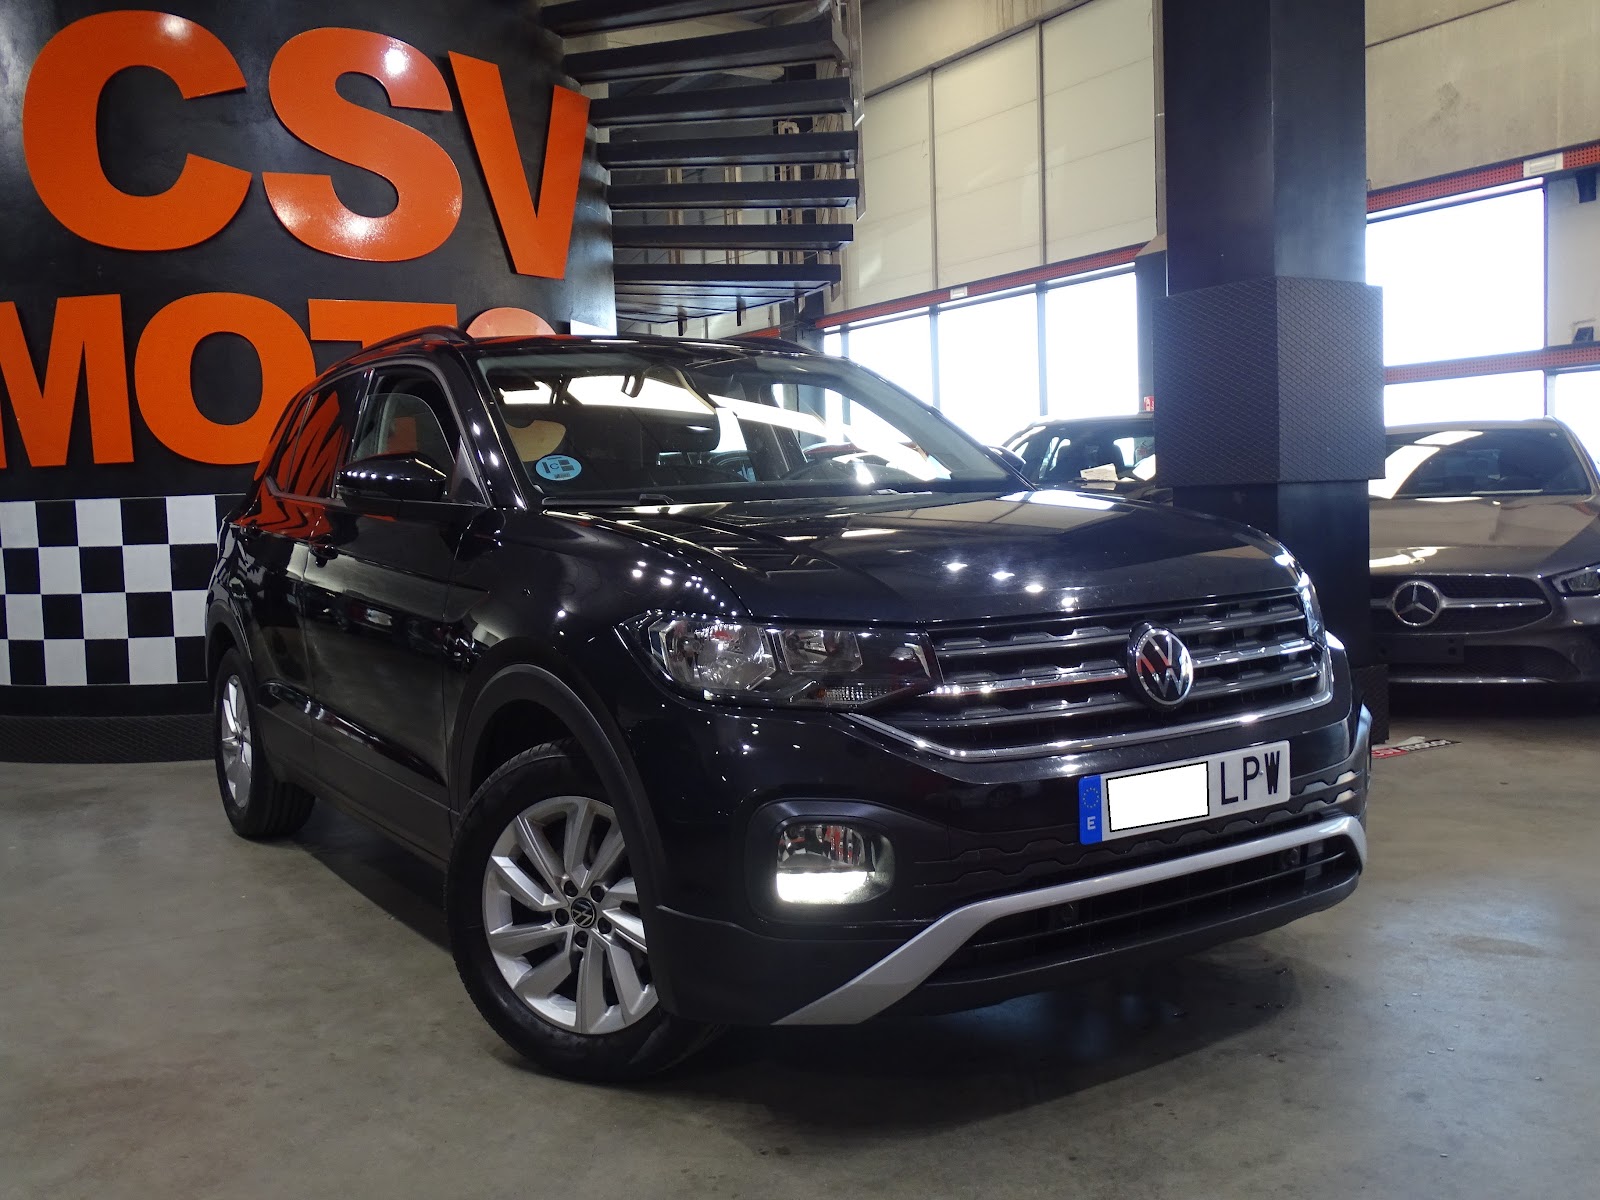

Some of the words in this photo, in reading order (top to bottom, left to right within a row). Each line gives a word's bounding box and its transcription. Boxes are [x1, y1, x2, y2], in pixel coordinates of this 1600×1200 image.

[22, 10, 591, 280] CSV
[0, 291, 557, 468] MO
[1087, 816, 1096, 830] E
[1220, 750, 1281, 805] LPW
